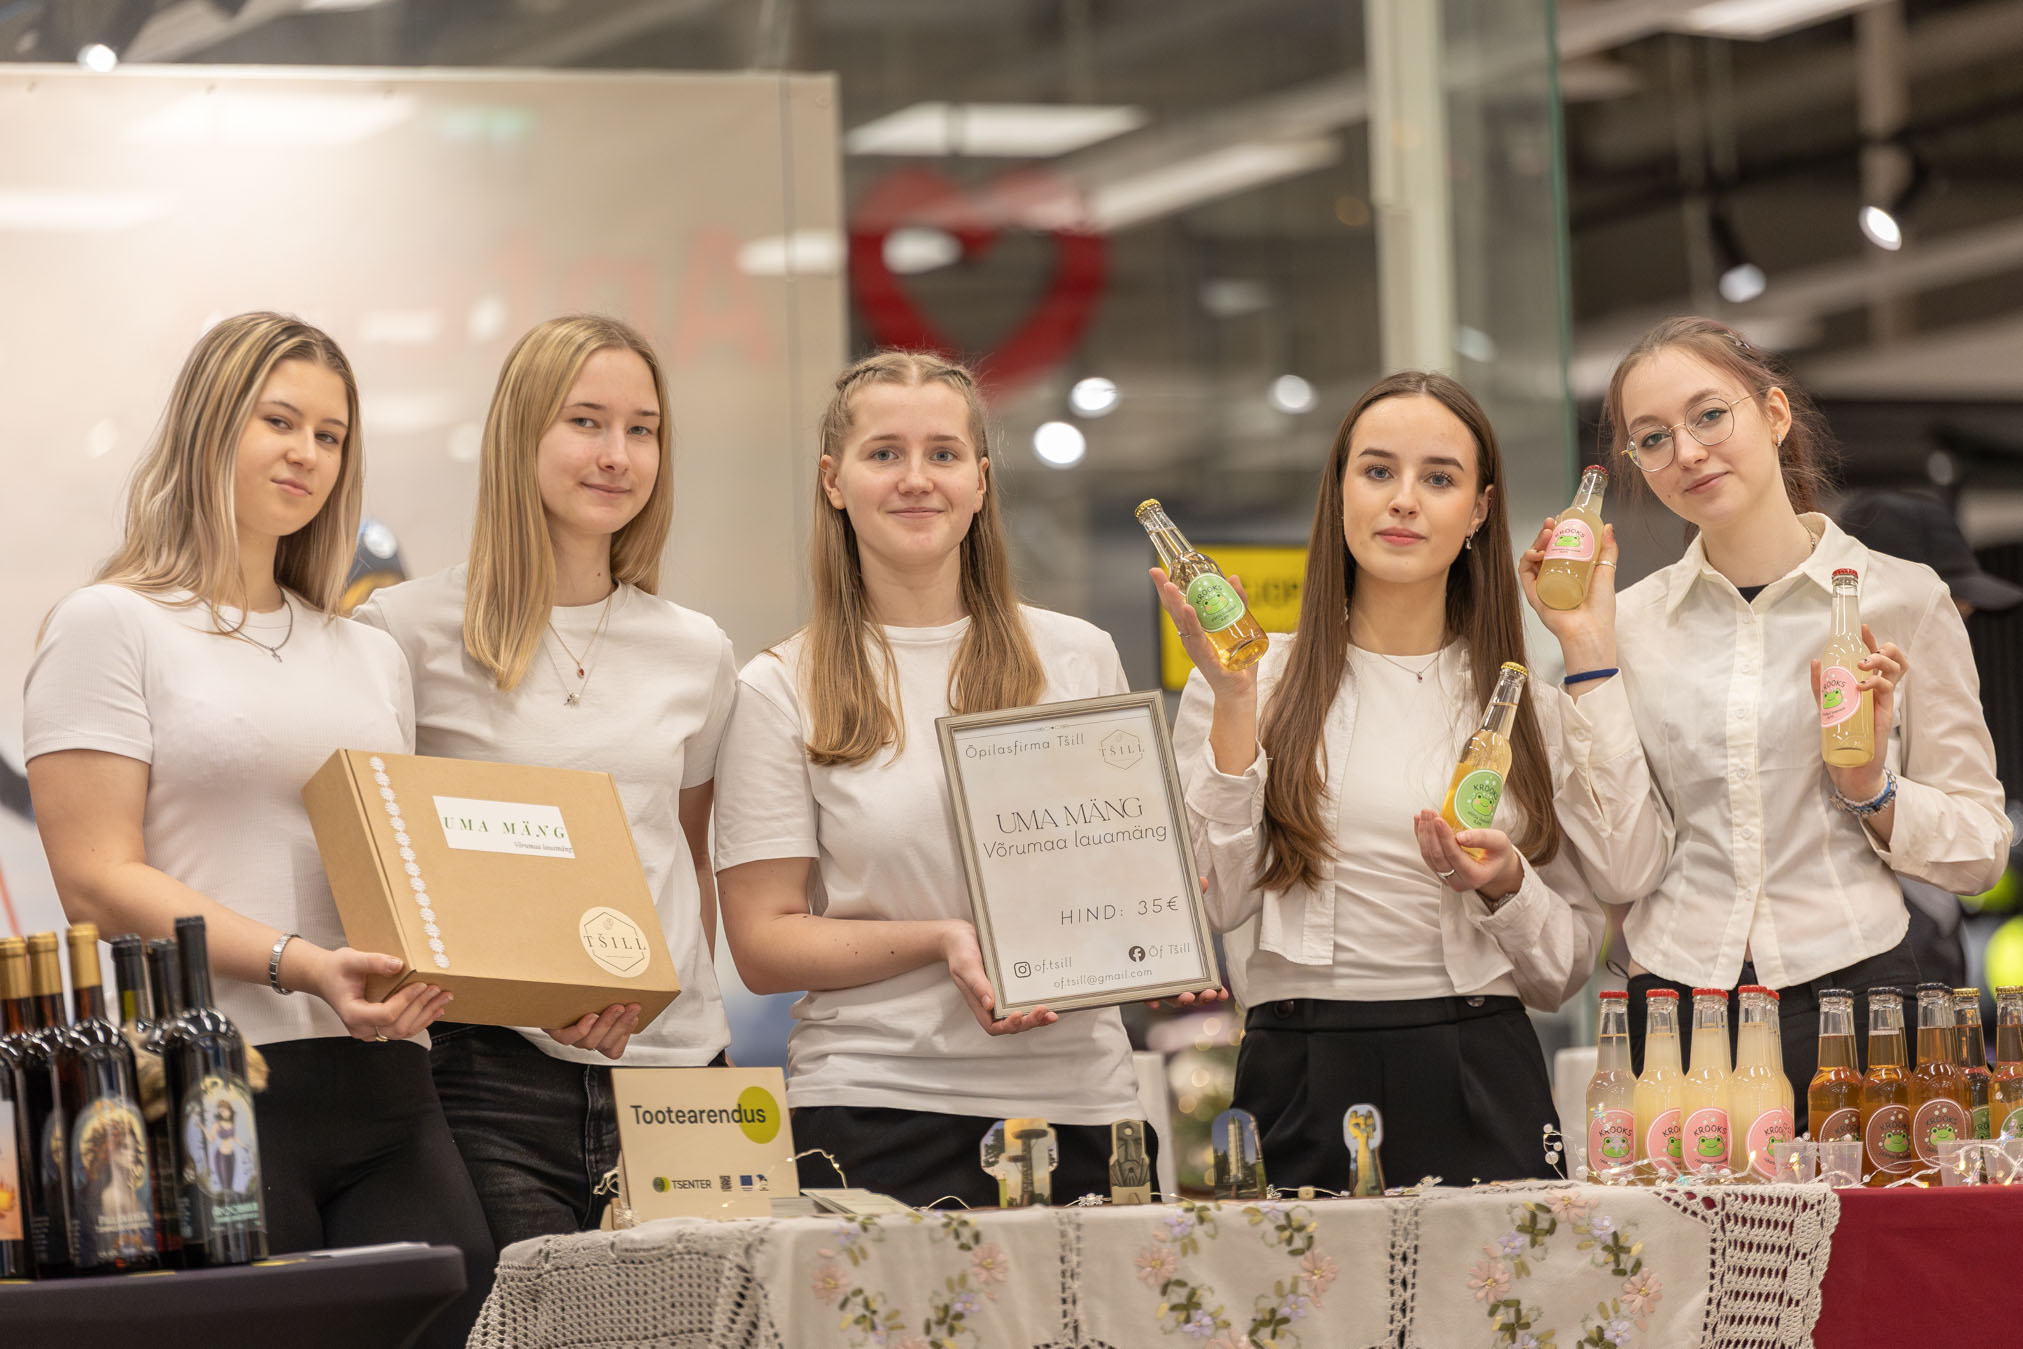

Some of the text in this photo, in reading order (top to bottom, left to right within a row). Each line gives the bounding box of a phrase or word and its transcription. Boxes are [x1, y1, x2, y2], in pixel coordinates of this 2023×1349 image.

[1195, 584, 1223, 605] KROOKS
[1822, 680, 1846, 692] ROOKS
[965, 733, 1085, 760] Õpilasfirma Tšill
[1099, 743, 1145, 758] TŠILL
[996, 796, 1144, 835] UMA MÄNG
[443, 816, 566, 838] UMA MÄNG
[983, 823, 1168, 859] Võrumaa lauamäng
[1060, 895, 1180, 926] HIND: 35€
[583, 932, 647, 951] TŠILL
[1148, 942, 1191, 960] Õf Tšill
[1033, 956, 1073, 974] of.tsill
[1053, 968, 1153, 989] of.tsill@gmail.com
[630, 1104, 766, 1124] Tootearendus
[1925, 1115, 1958, 1127] KROOKS
[1598, 1125, 1633, 1138] KROOKS
[1662, 1124, 1681, 1138] KRO
[1693, 1124, 1728, 1137] KROOKS
[671, 1179, 712, 1190] TSENTER
